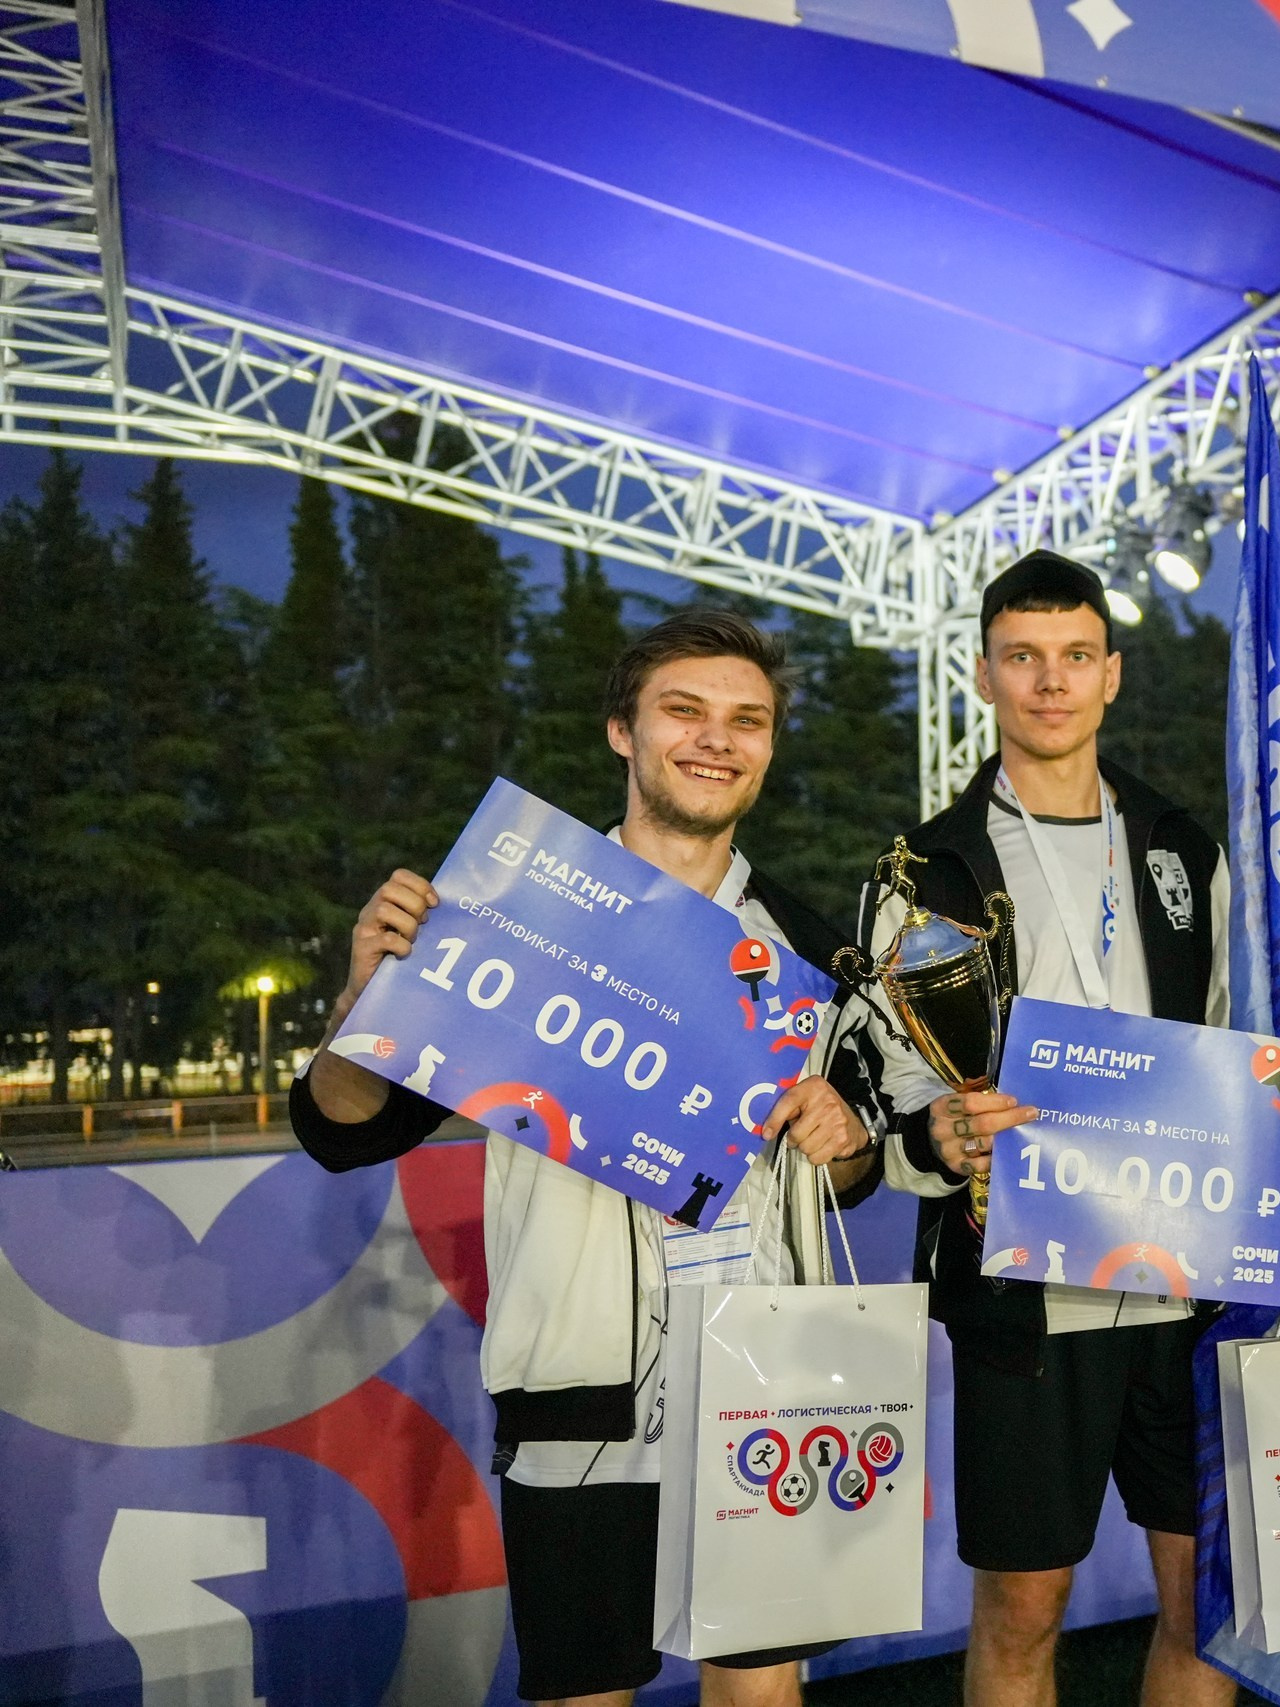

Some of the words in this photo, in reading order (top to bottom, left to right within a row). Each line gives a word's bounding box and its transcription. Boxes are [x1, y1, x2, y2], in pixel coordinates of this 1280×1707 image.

[525, 869, 594, 913] ЛОГИСТИКА
[532, 849, 633, 915] МАГНИТ
[458, 896, 569, 961] СЕРТИФИКАТ
[568, 954, 589, 975] ЗА
[590, 964, 608, 982] 3
[606, 975, 659, 1011] МЕСТО
[659, 1005, 681, 1025] НА
[419, 937, 515, 1010] 10
[535, 994, 668, 1091] 000
[1063, 1063, 1127, 1080] ЛОГИСТИКА
[1065, 1043, 1156, 1072] МАГНИТ
[1036, 1108, 1121, 1131] РТИФИКАТ
[1122, 1120, 1141, 1134] ЗА
[1144, 1119, 1157, 1136] 3
[1160, 1125, 1208, 1142] МЕСТО
[1211, 1132, 1230, 1145] НА
[631, 1131, 686, 1167] СОЧИ
[621, 1154, 671, 1186] 2025
[1018, 1144, 1089, 1195] 10
[1117, 1156, 1234, 1213] 000
[1232, 1245, 1279, 1263] СОЧИ
[1232, 1267, 1274, 1284] 2025
[719, 1410, 768, 1421] ПЕРВАЯ
[777, 1405, 872, 1418] ЛОГИСТИЧЕСКАЯ
[880, 1403, 908, 1413] ТВОЯ
[727, 1454, 766, 1496] СПАРТАКИАДА
[728, 1507, 759, 1516] МАГНИТ
